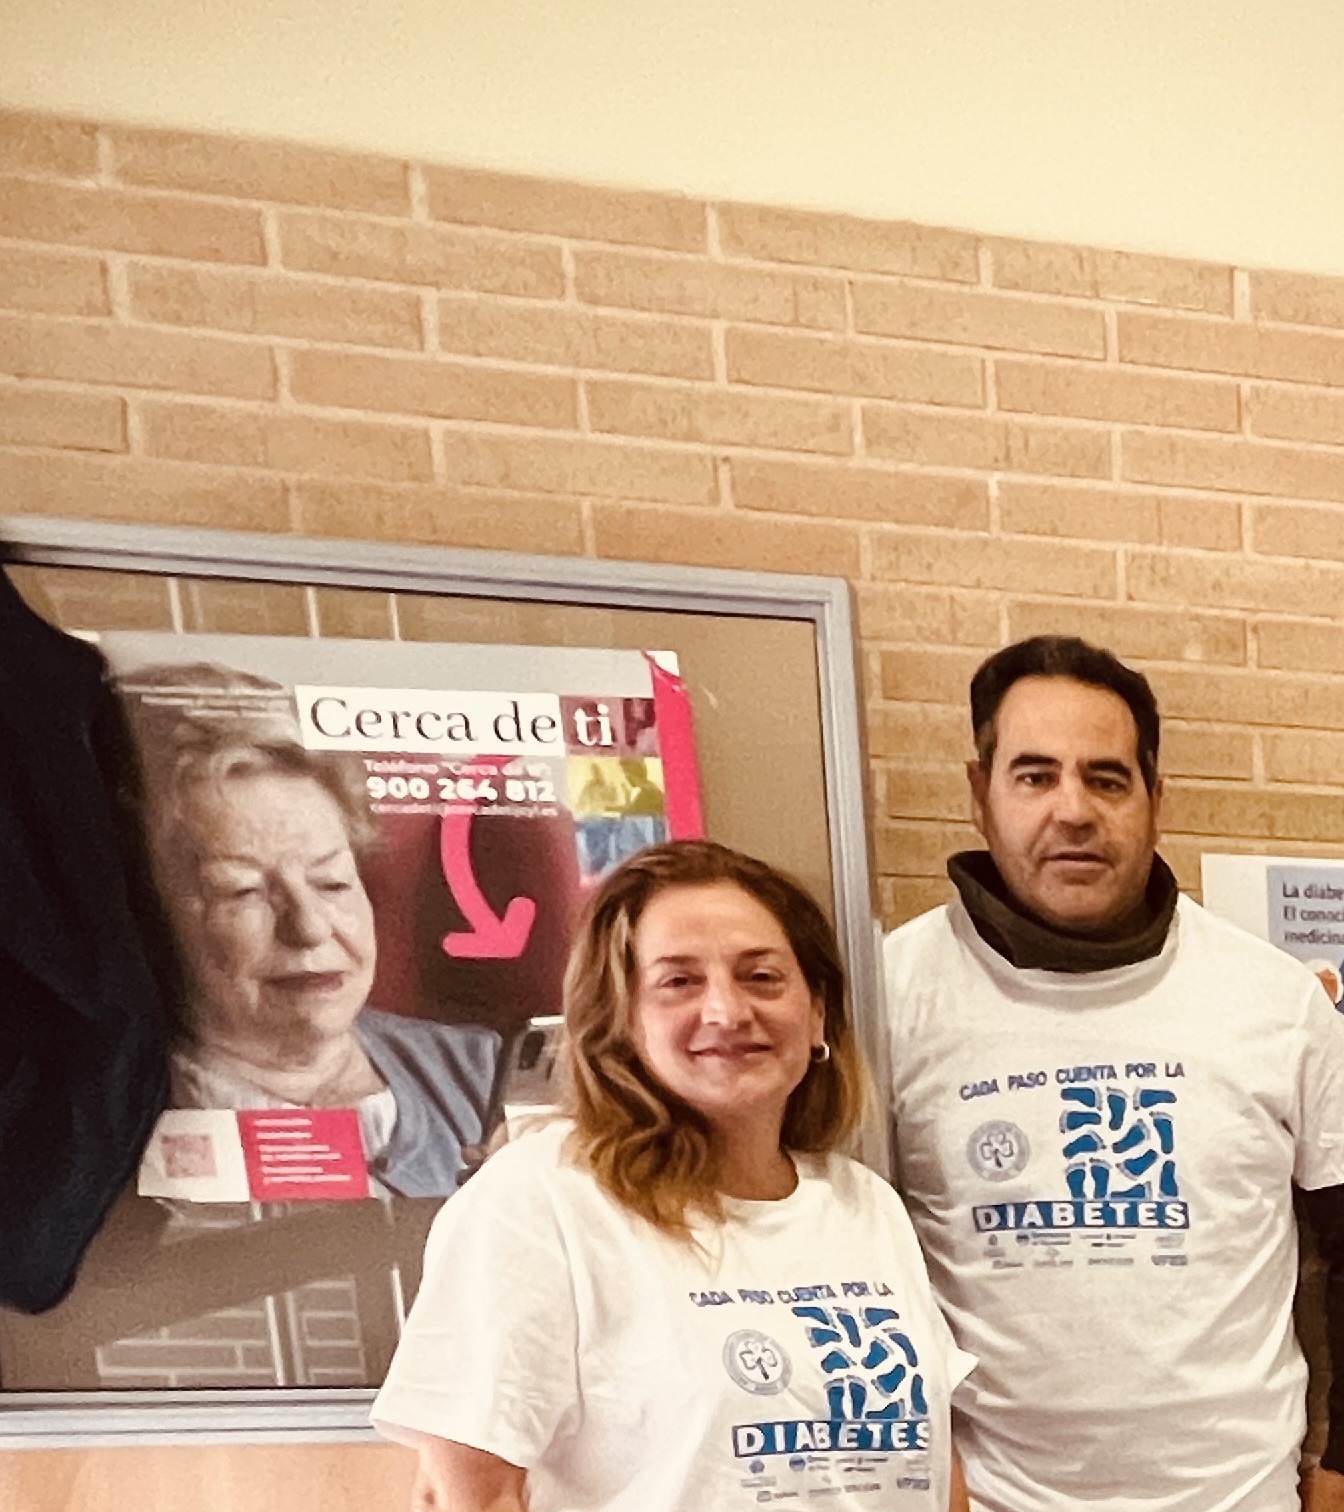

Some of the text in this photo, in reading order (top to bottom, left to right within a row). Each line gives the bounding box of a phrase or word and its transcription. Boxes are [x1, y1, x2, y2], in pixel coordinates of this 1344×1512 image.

[310, 697, 615, 746] Cerca de ti
[366, 776, 430, 799] 900
[437, 778, 499, 801] 264
[1282, 882, 1300, 898] La
[1283, 906, 1296, 921] El
[959, 1062, 1185, 1101] CADA PASO CUENTA POR LA
[976, 1203, 1187, 1229] DIABETES
[840, 1281, 872, 1297] POR
[736, 1422, 929, 1455] DIABETES
